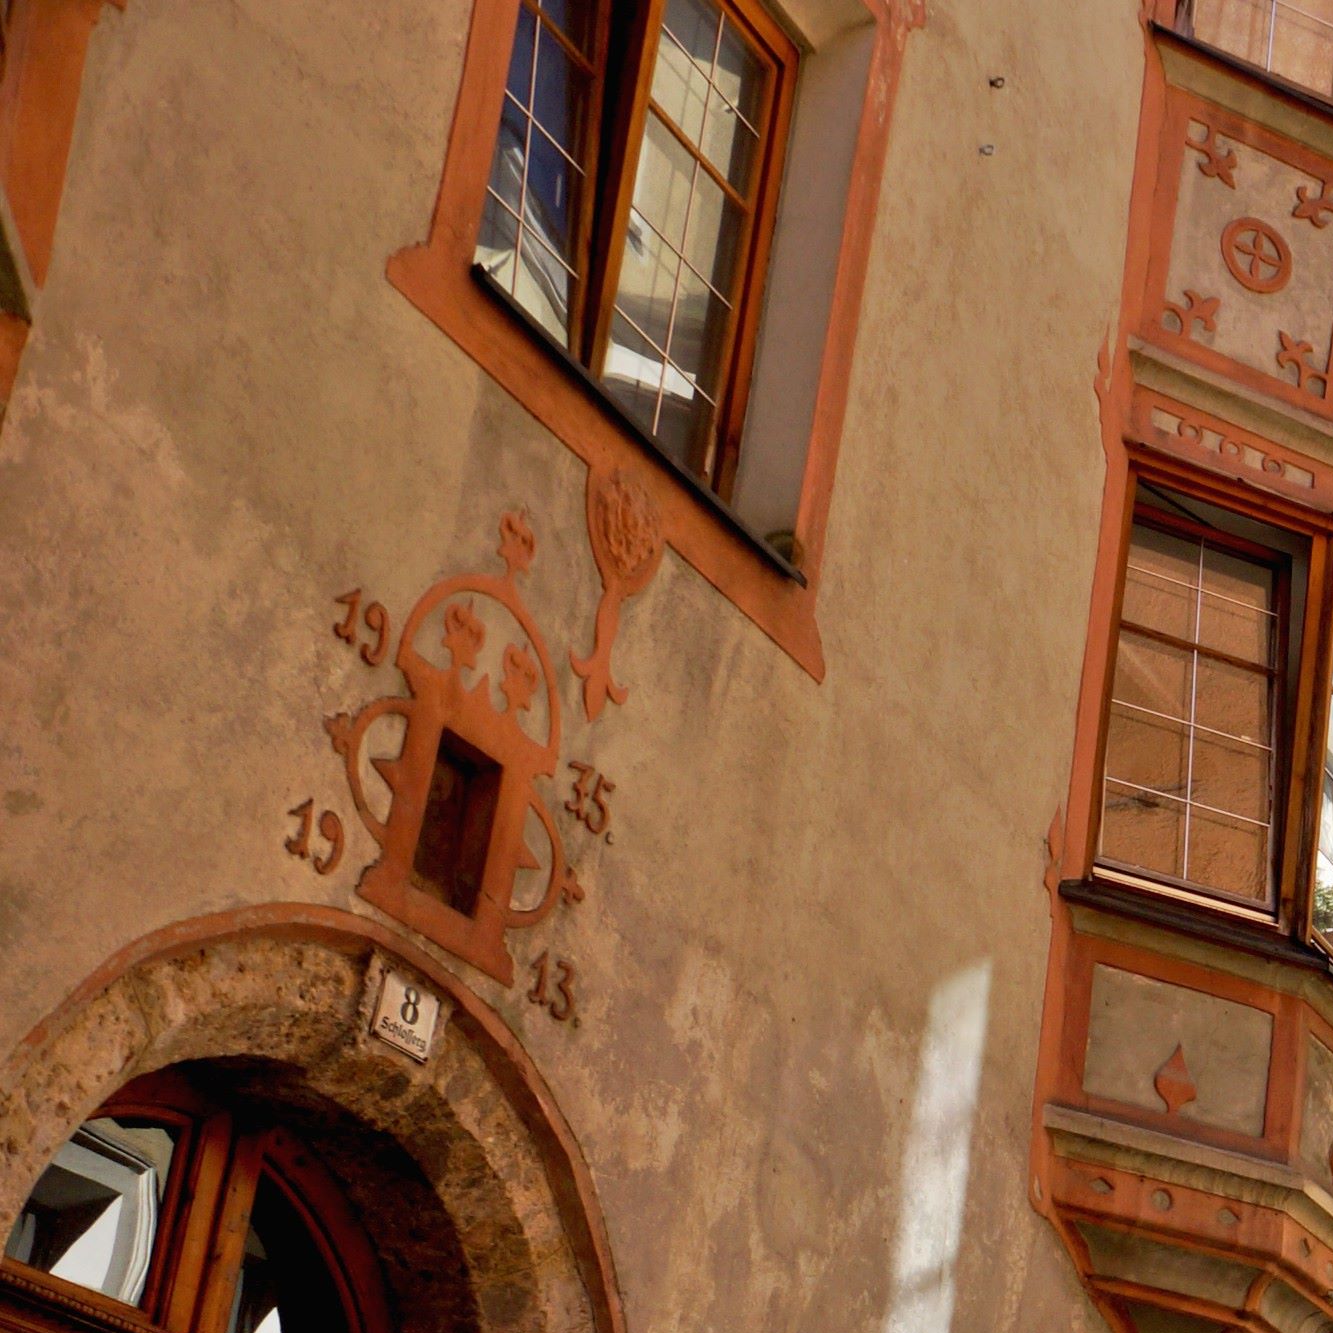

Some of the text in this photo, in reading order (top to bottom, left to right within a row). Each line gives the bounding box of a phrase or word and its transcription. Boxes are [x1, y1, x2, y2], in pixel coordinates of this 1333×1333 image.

[332, 588, 390, 667] 19
[285, 798, 345, 876] 19
[400, 986, 421, 1026] 8
